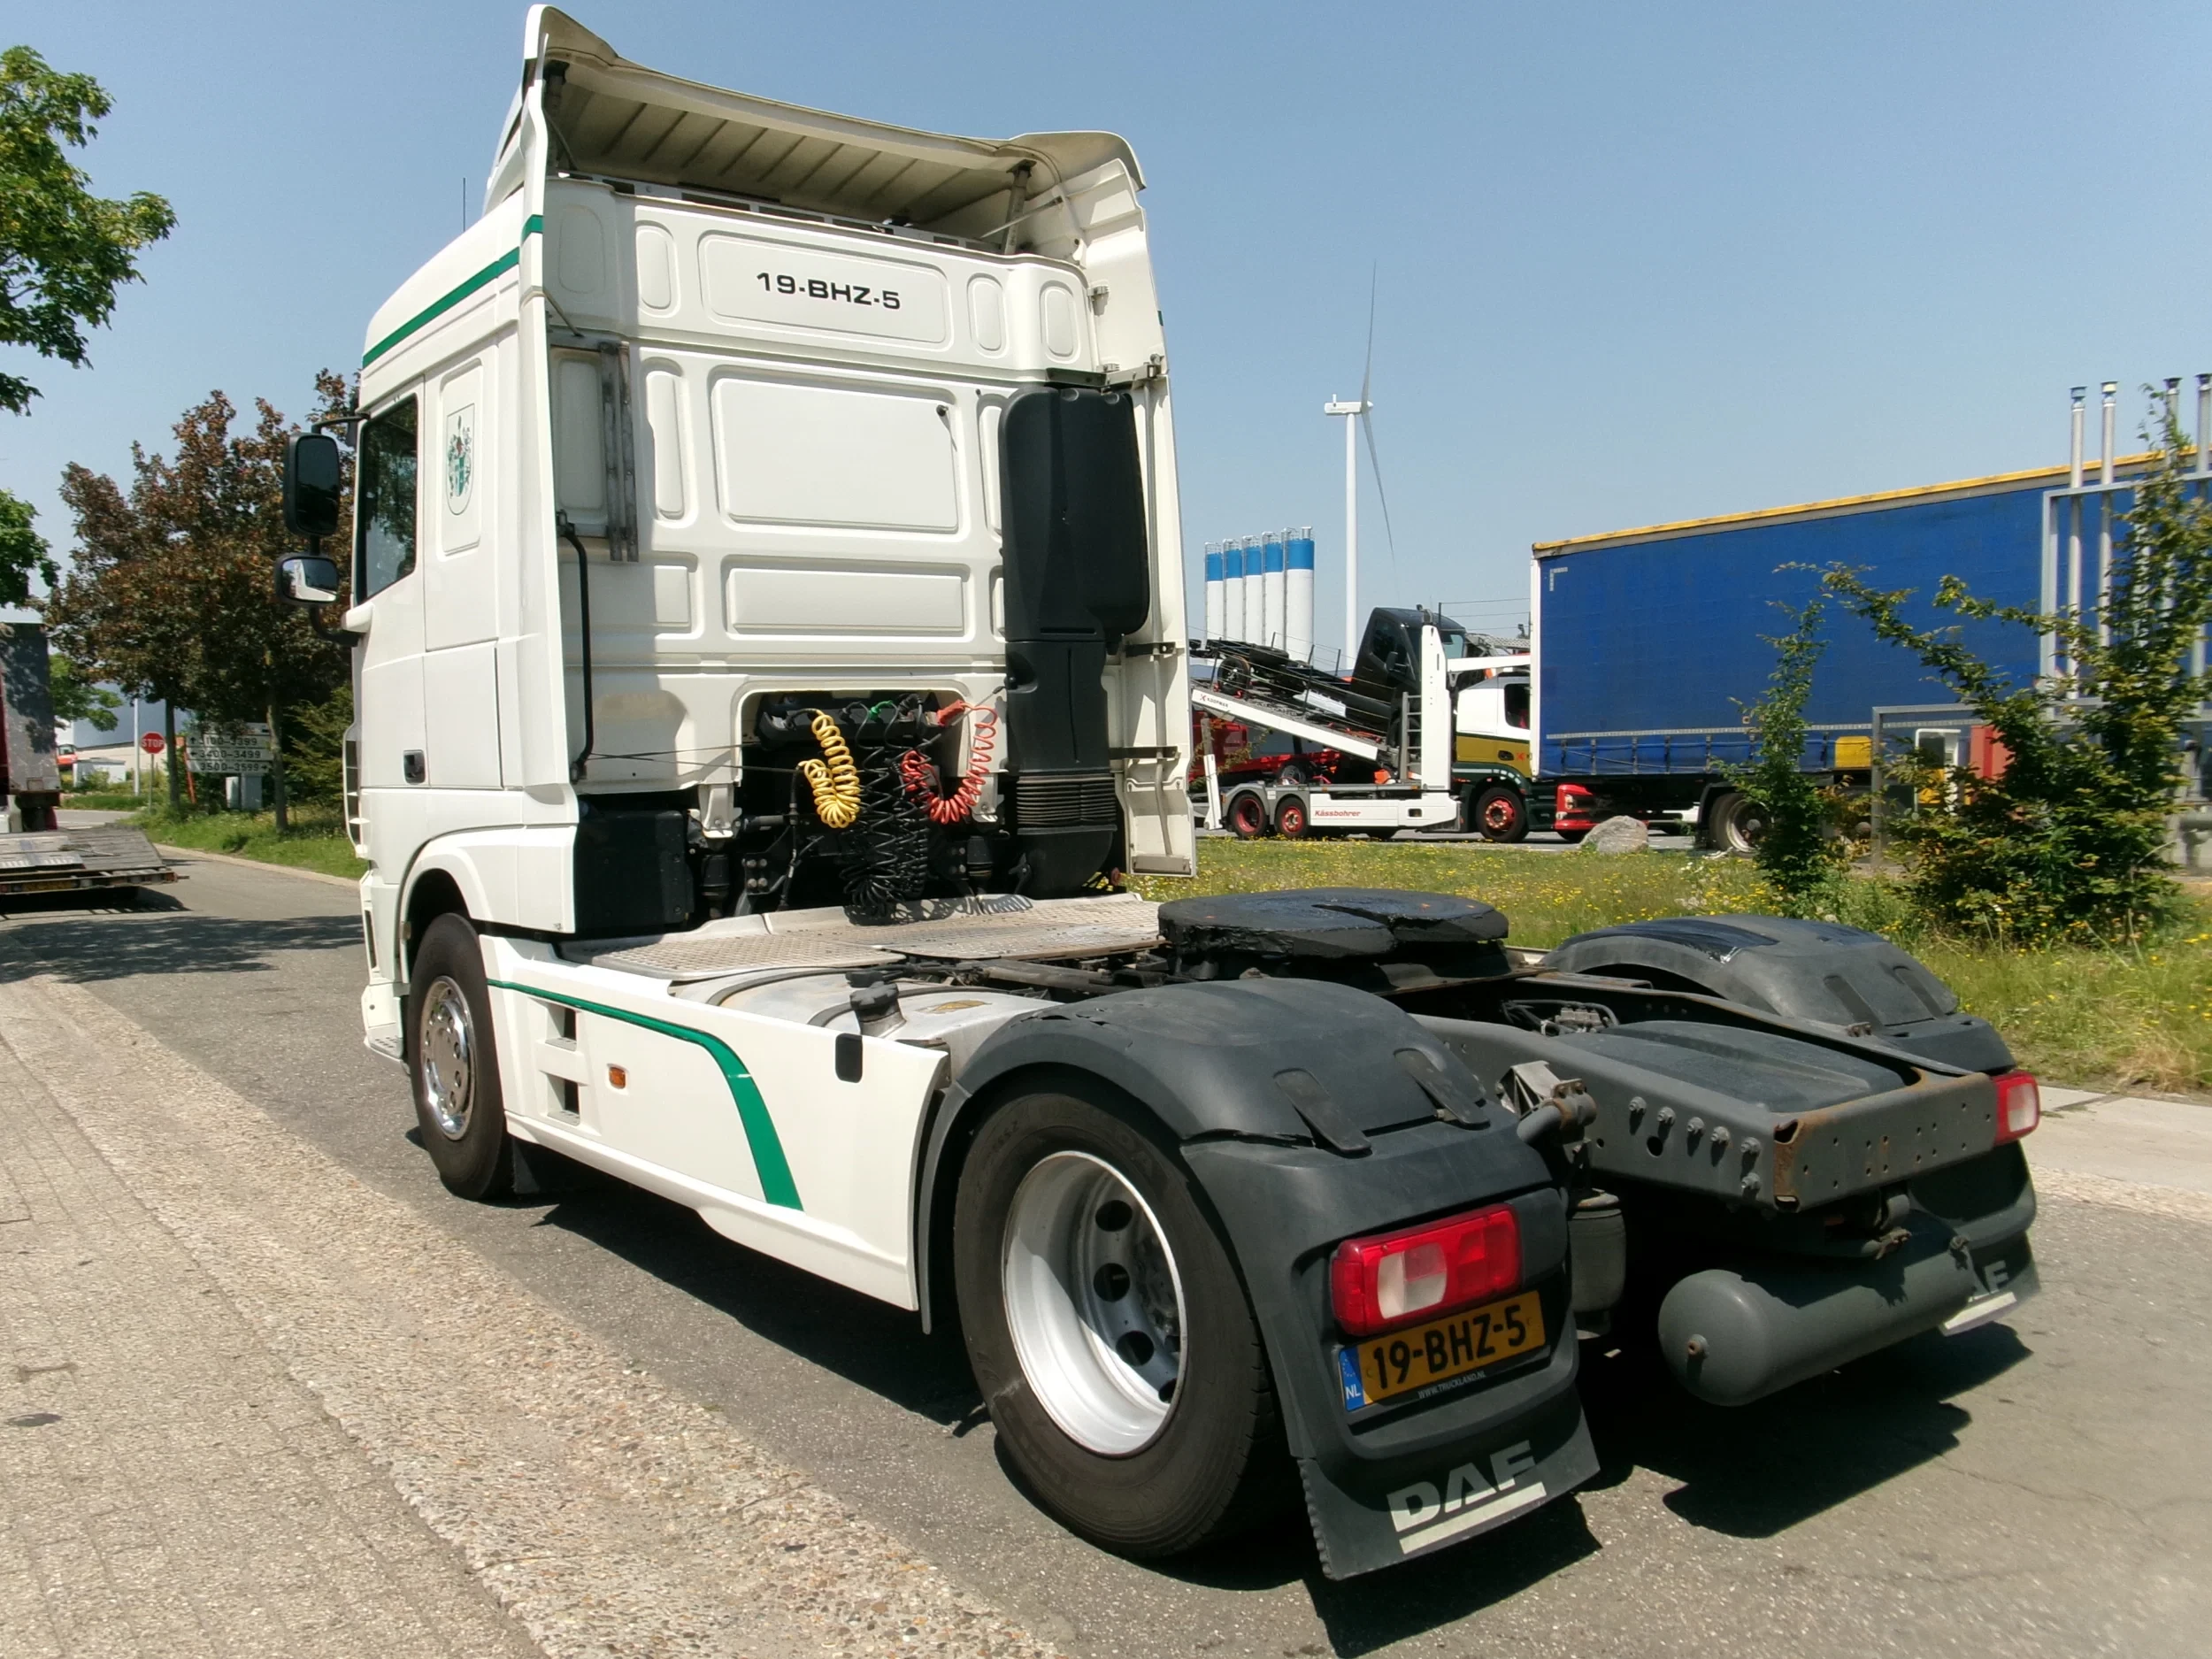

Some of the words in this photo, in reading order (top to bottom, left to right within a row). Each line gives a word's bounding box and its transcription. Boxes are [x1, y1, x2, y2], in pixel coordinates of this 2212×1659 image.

[757, 273, 901, 310] 19-BHZ-5
[142, 738, 165, 748] STOP
[1373, 1304, 1527, 1390] 19-BHZ-5
[1346, 1386, 1362, 1401] NL
[1386, 1440, 1536, 1532] DAF
